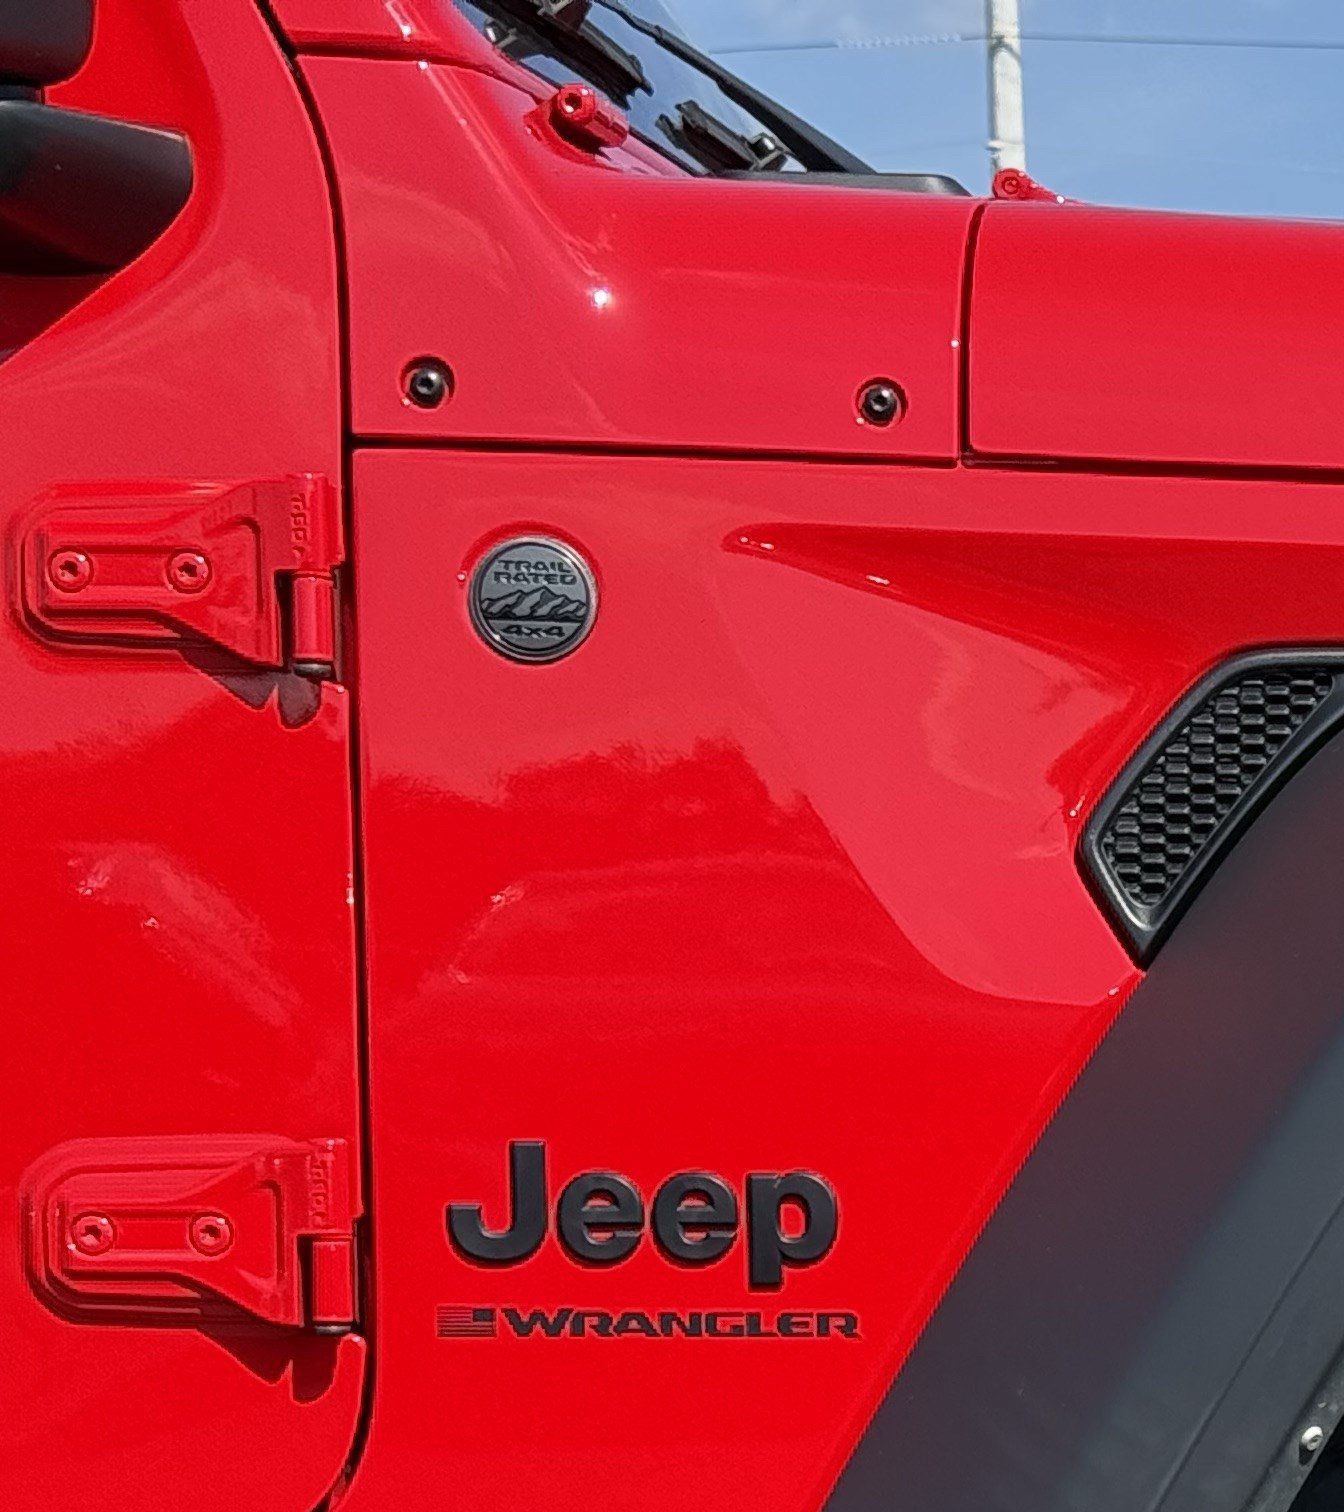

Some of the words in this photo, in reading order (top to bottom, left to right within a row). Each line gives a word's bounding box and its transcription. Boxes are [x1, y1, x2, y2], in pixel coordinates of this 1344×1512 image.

[498, 560, 571, 573] TRAIL
[494, 572, 577, 586] RATED
[447, 1139, 838, 1291] Jeep
[502, 1307, 861, 1339] WRANGLER
